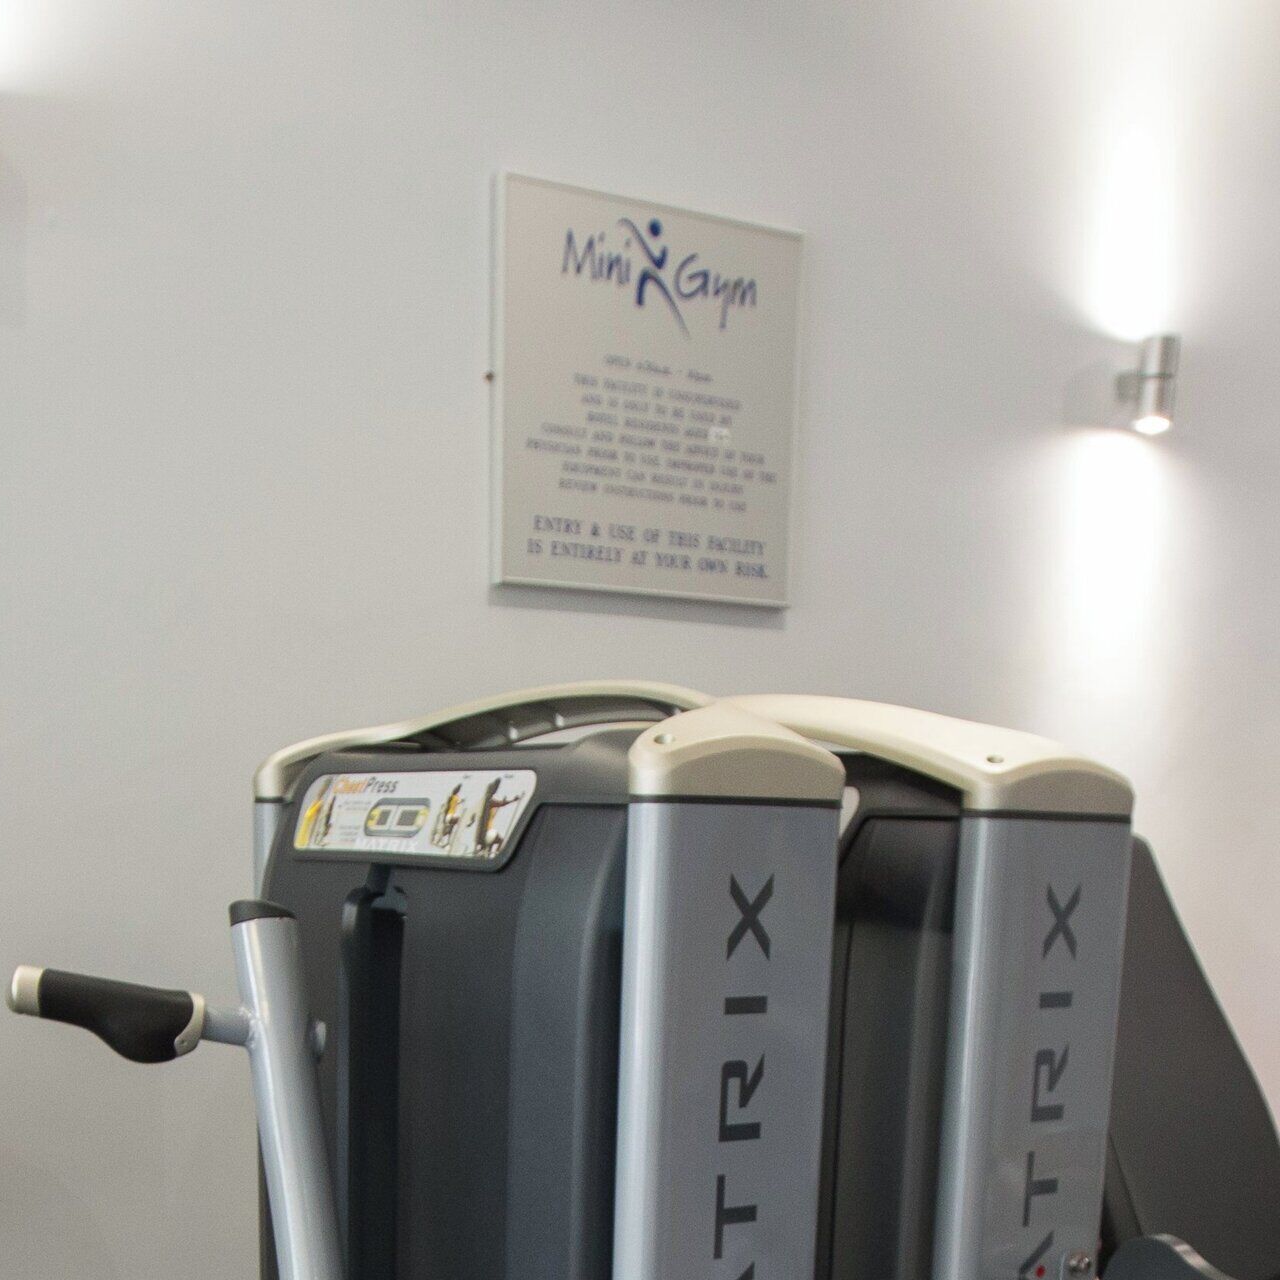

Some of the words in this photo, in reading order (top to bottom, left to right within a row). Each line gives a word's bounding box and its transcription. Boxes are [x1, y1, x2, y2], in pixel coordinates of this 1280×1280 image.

[562, 227, 632, 285] Mini
[673, 252, 757, 330] Gym
[526, 538, 542, 554] IS
[551, 540, 624, 562] ENTIRELY
[631, 549, 648, 566] AT
[655, 552, 692, 570] YOUR
[698, 556, 728, 574] OWN
[533, 514, 581, 536] ENTRY
[608, 523, 637, 542] USE
[642, 528, 661, 544] OF
[668, 530, 700, 549] THIS
[706, 534, 765, 556] FACILITY
